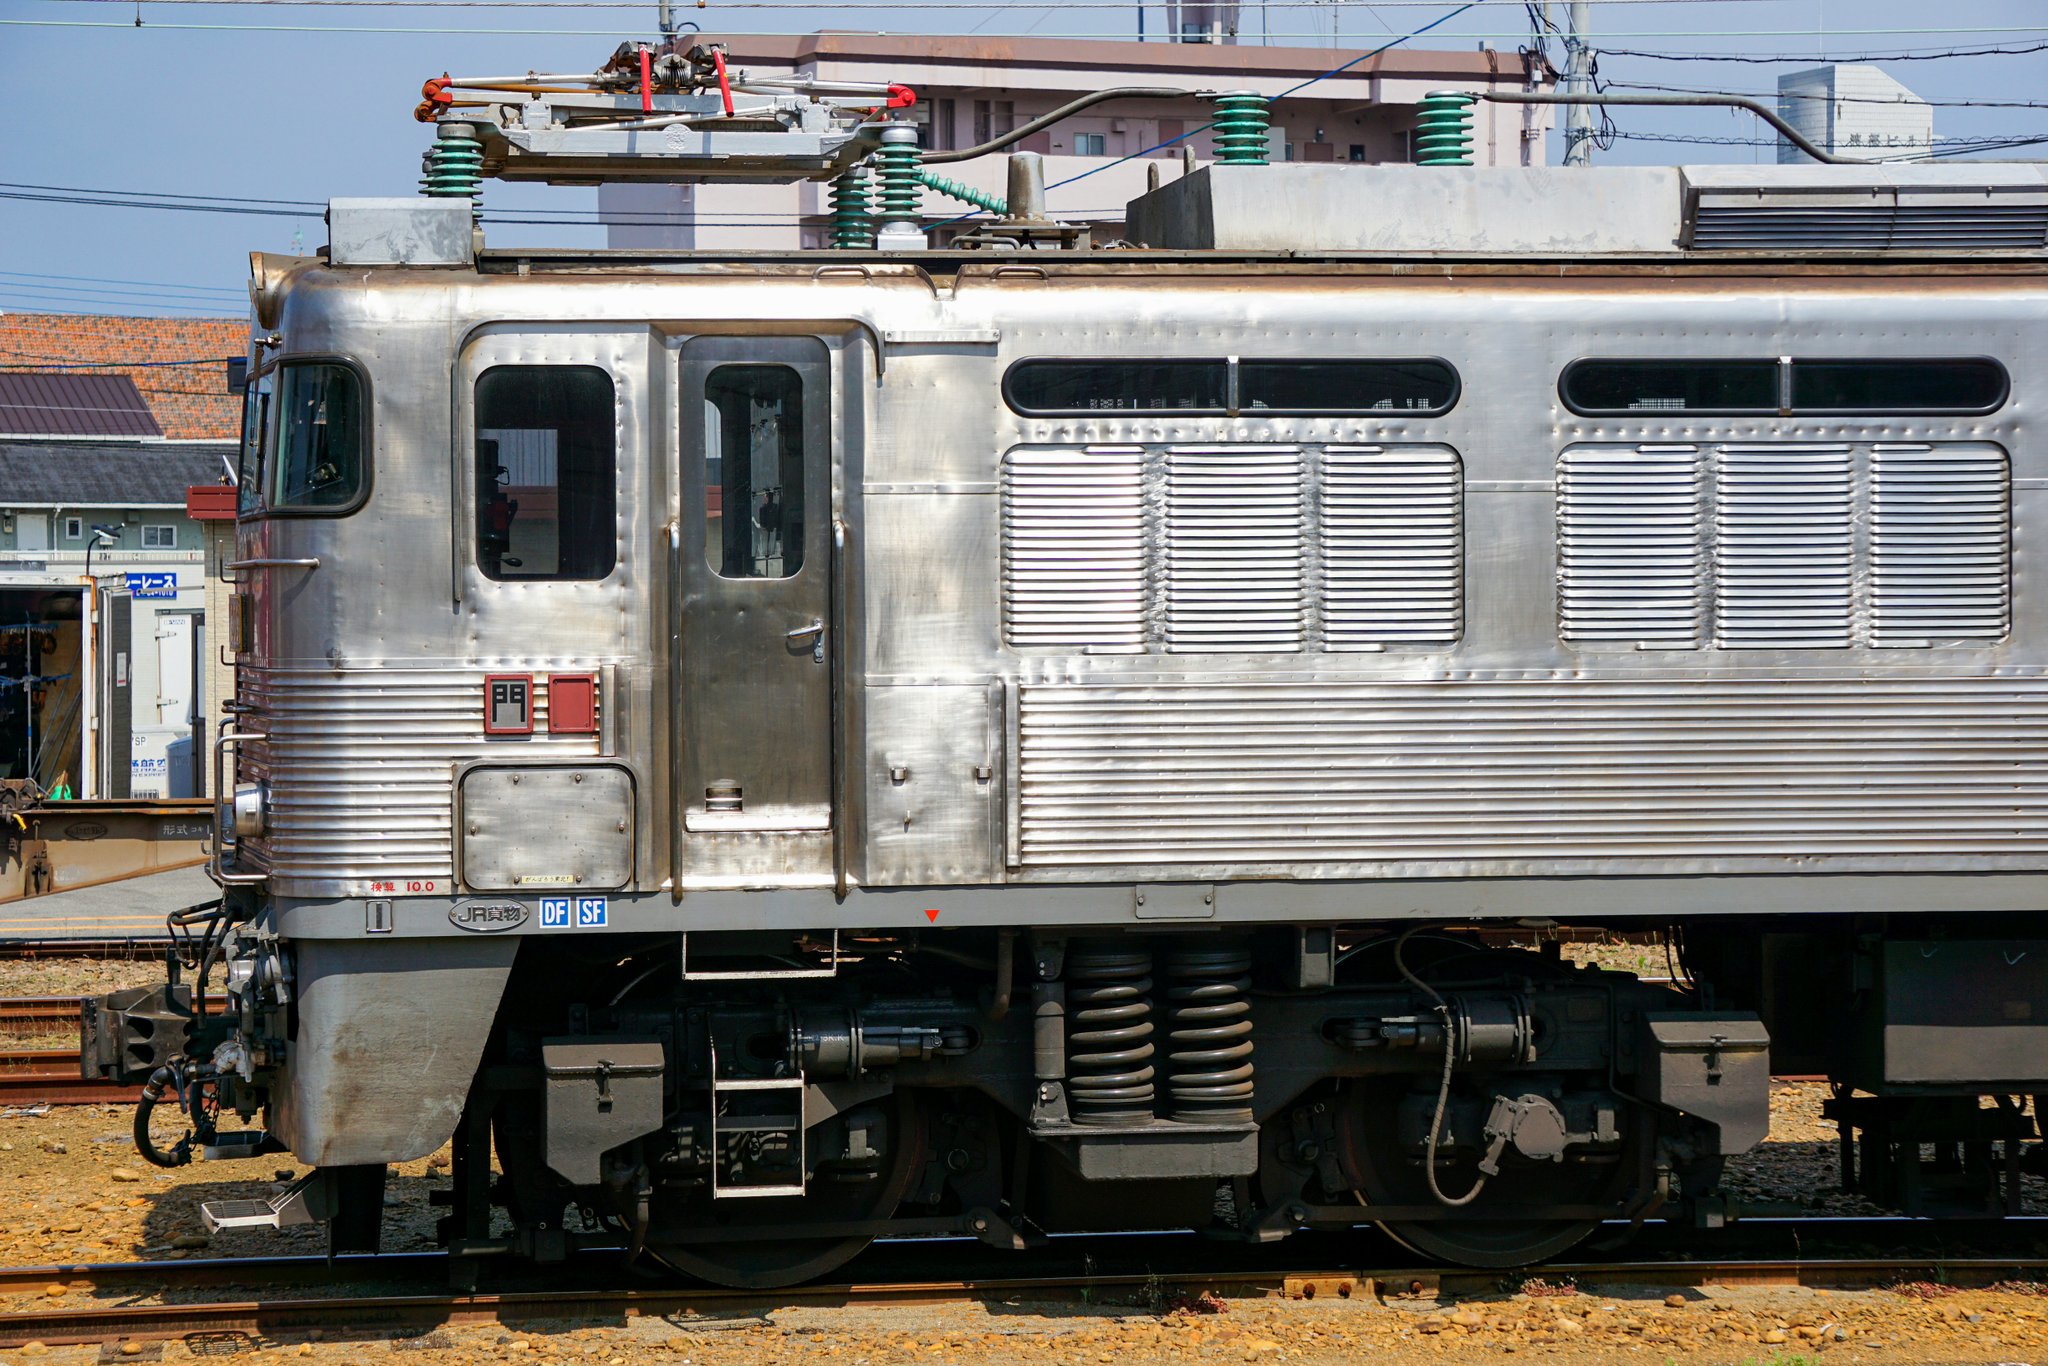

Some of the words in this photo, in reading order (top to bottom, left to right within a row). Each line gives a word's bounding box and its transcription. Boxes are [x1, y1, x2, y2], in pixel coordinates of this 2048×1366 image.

[492, 684, 526, 722] 門
[163, 824, 188, 835] 形式
[407, 881, 435, 892] 10.0
[458, 906, 521, 922] JR貨物
[545, 902, 566, 924] DF
[582, 900, 602, 923] SF
